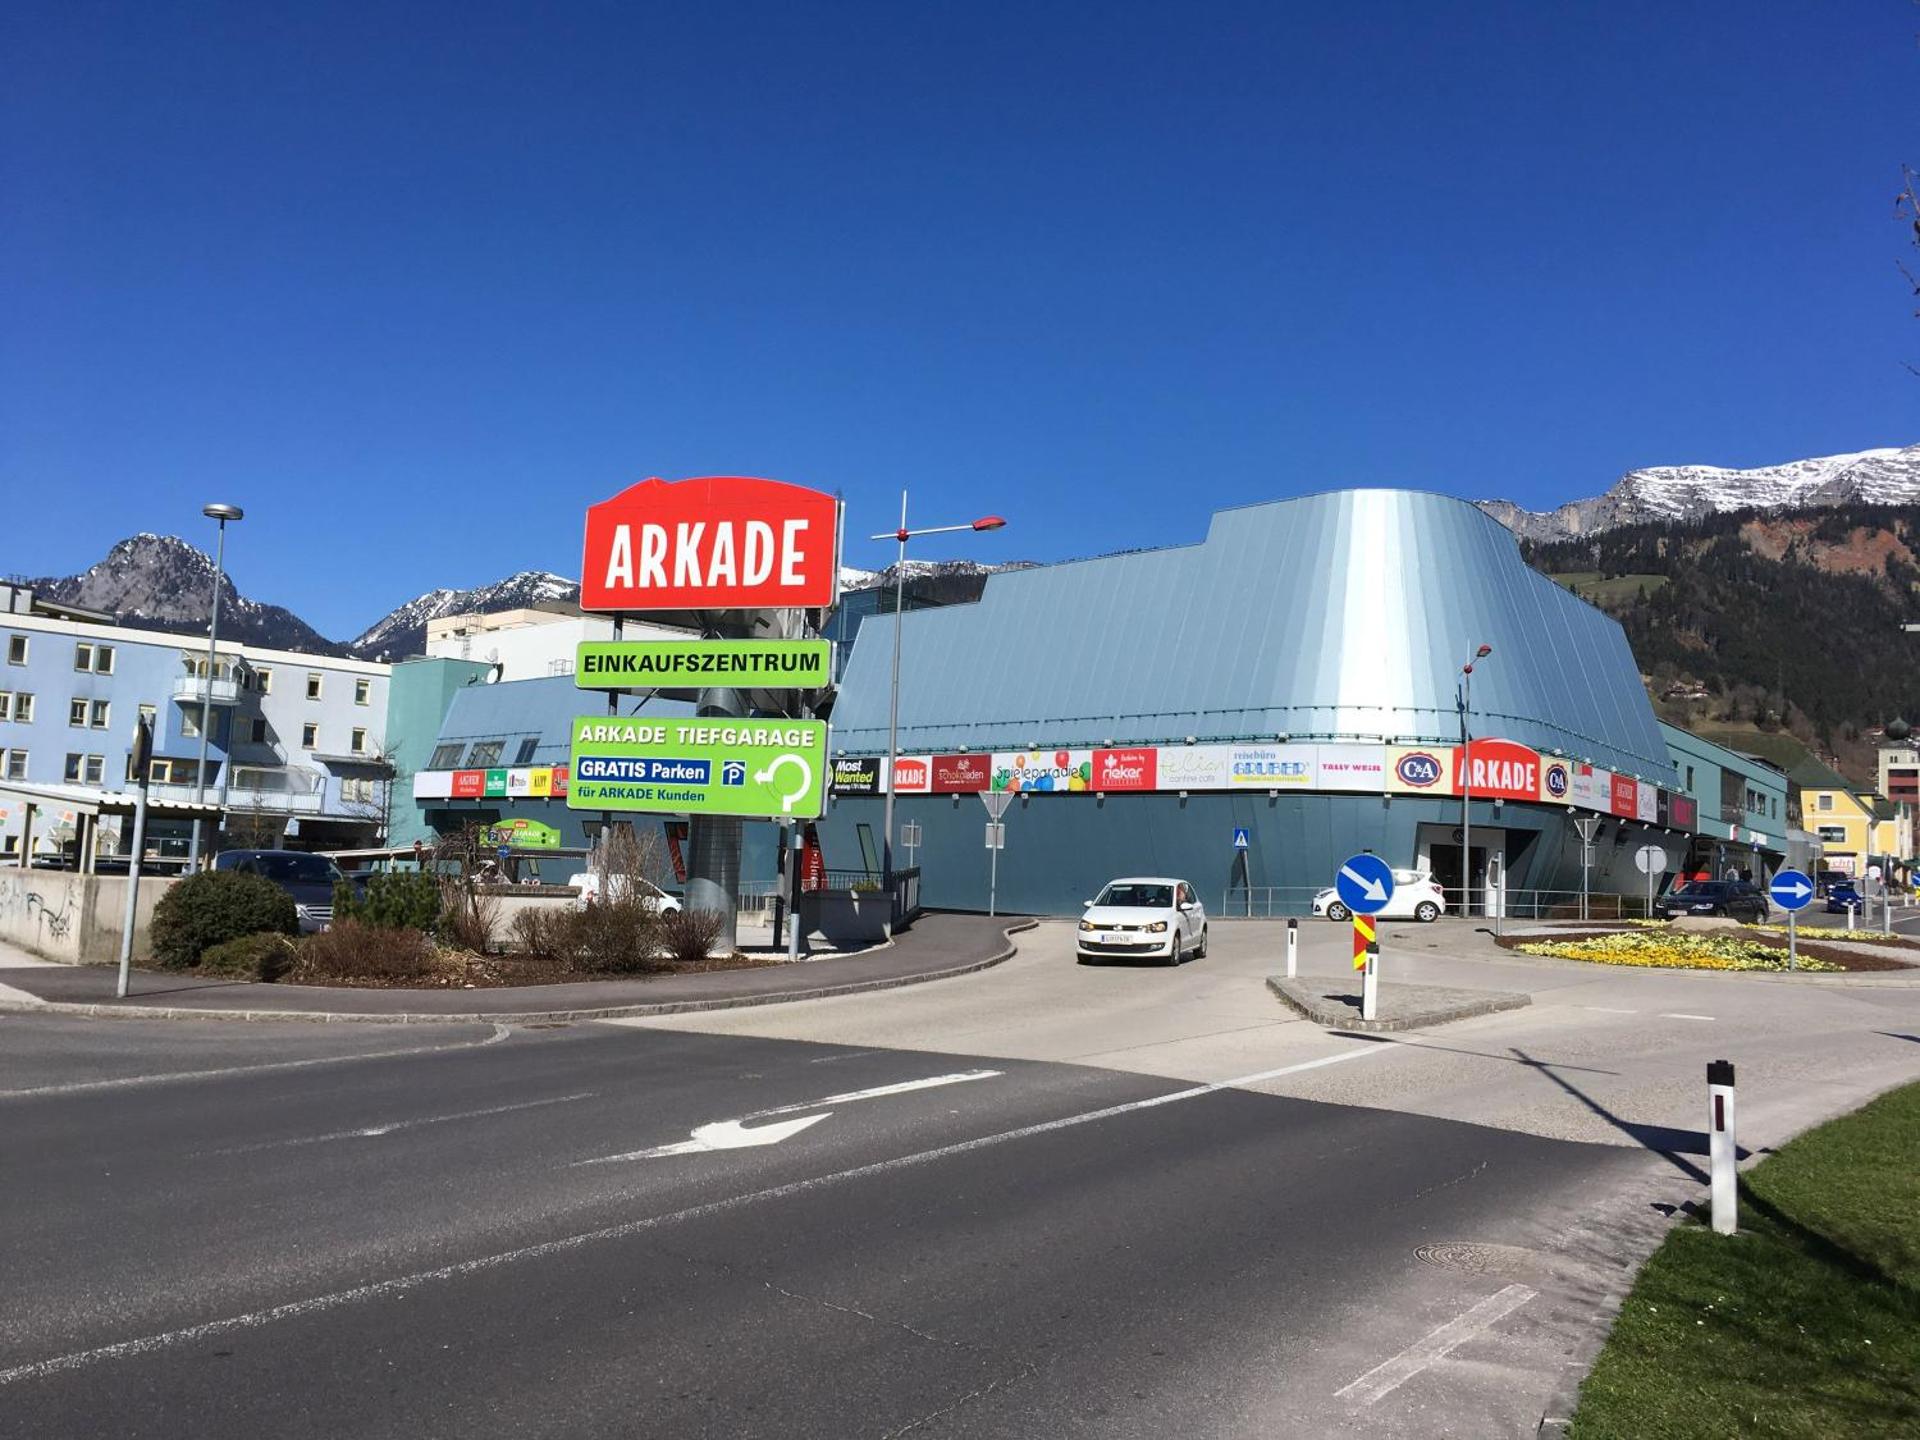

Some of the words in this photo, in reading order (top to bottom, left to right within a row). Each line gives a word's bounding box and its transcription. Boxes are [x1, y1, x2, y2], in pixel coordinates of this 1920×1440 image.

[605, 519, 809, 589] ARKADE
[584, 653, 820, 673] EINKAUFSZENTRUM
[580, 725, 666, 743] ARKADE
[677, 727, 815, 747] TIEFGARAGE
[580, 760, 646, 778] GRATIS
[651, 762, 705, 779] Parken
[836, 760, 862, 772] Most
[1102, 765, 1144, 779] rieker
[1404, 761, 1434, 779] C&A
[1458, 757, 1535, 792] ARKADE
[835, 770, 874, 783] Wanted
[578, 786, 596, 798] für
[598, 787, 654, 799] ARKADE
[657, 789, 705, 801] Kunden
